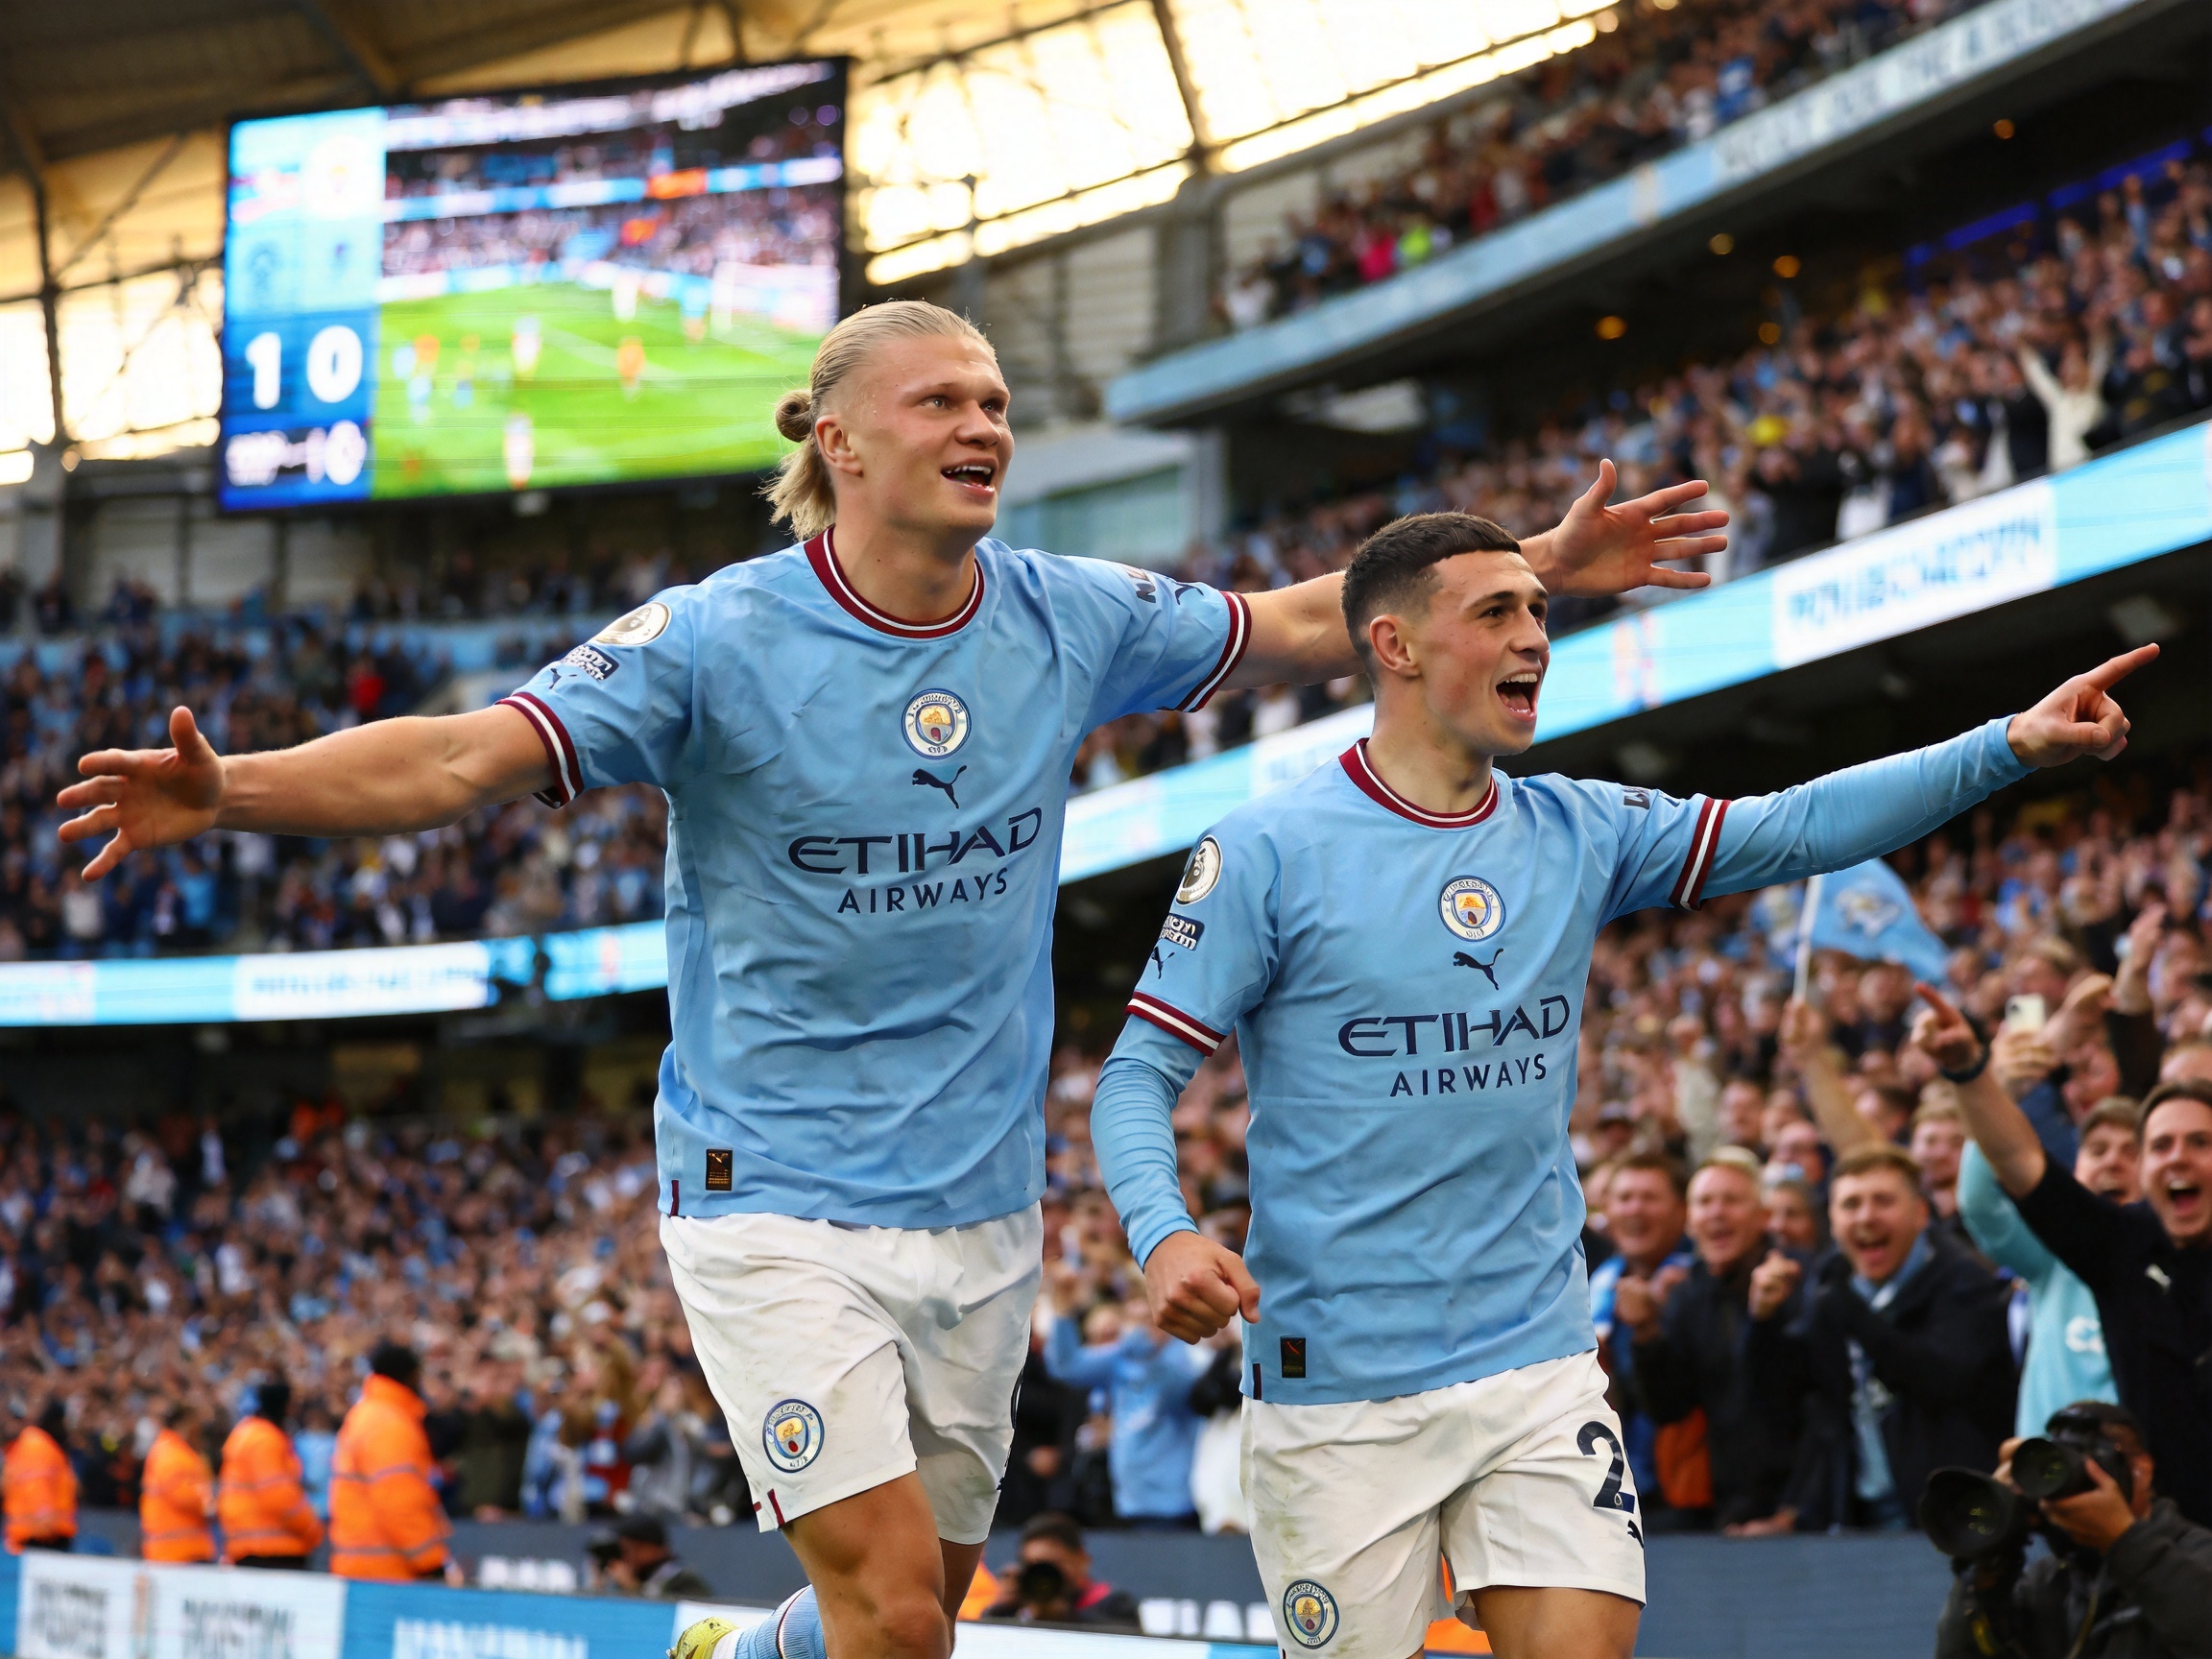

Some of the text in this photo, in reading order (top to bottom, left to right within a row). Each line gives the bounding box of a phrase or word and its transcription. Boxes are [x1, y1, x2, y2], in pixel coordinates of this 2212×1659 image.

[245, 324, 363, 410] 1 0
[787, 806, 1043, 875] ETIHAD
[836, 866, 1008, 914] AIRWAYS
[1337, 994, 1571, 1057] ETIHAD
[1389, 1052, 1548, 1097] AIRWAYS
[1575, 1420, 1636, 1515] 2
